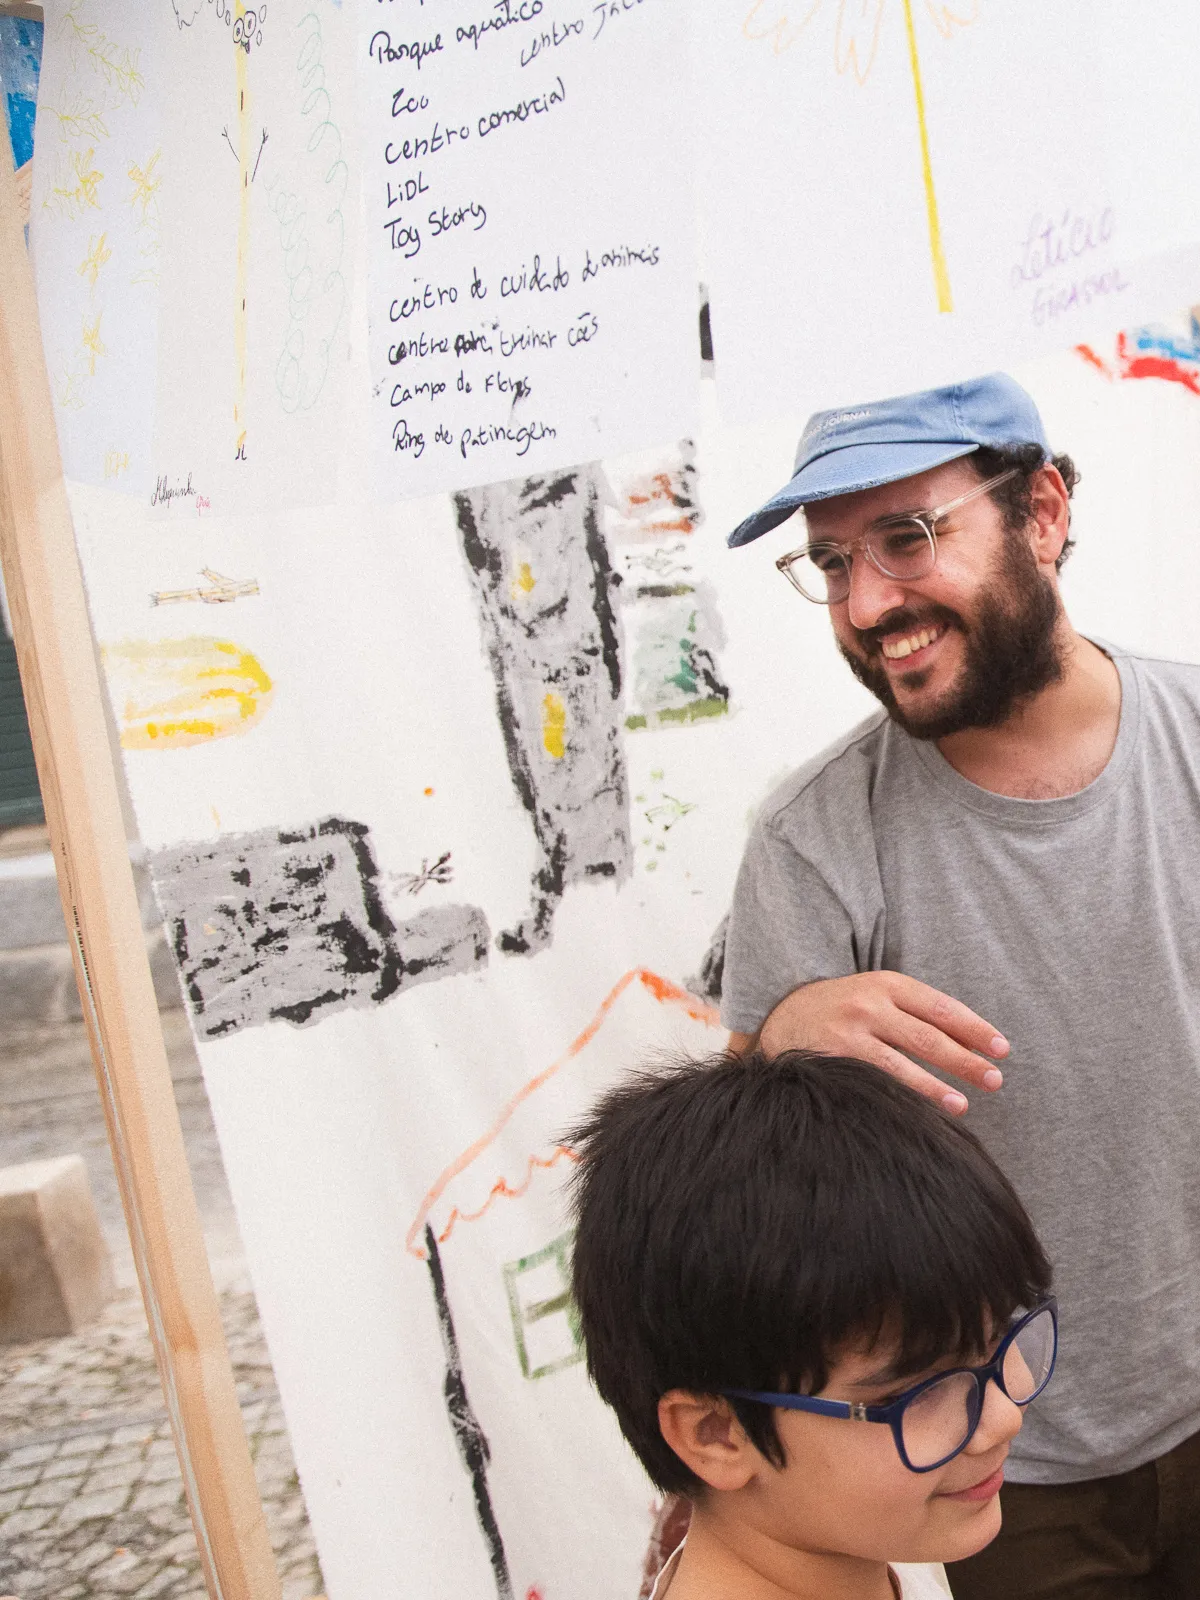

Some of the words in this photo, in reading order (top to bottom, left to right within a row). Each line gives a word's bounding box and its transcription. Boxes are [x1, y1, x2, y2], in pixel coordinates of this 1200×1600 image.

[369, 30, 445, 70] Parque
[477, 75, 566, 138] comercial
[384, 217, 421, 258] Toy
[427, 201, 488, 237] Story
[499, 254, 570, 298] cuidado
[499, 325, 558, 357] treinar
[433, 423, 454, 446] de
[459, 419, 557, 459] patinagem
